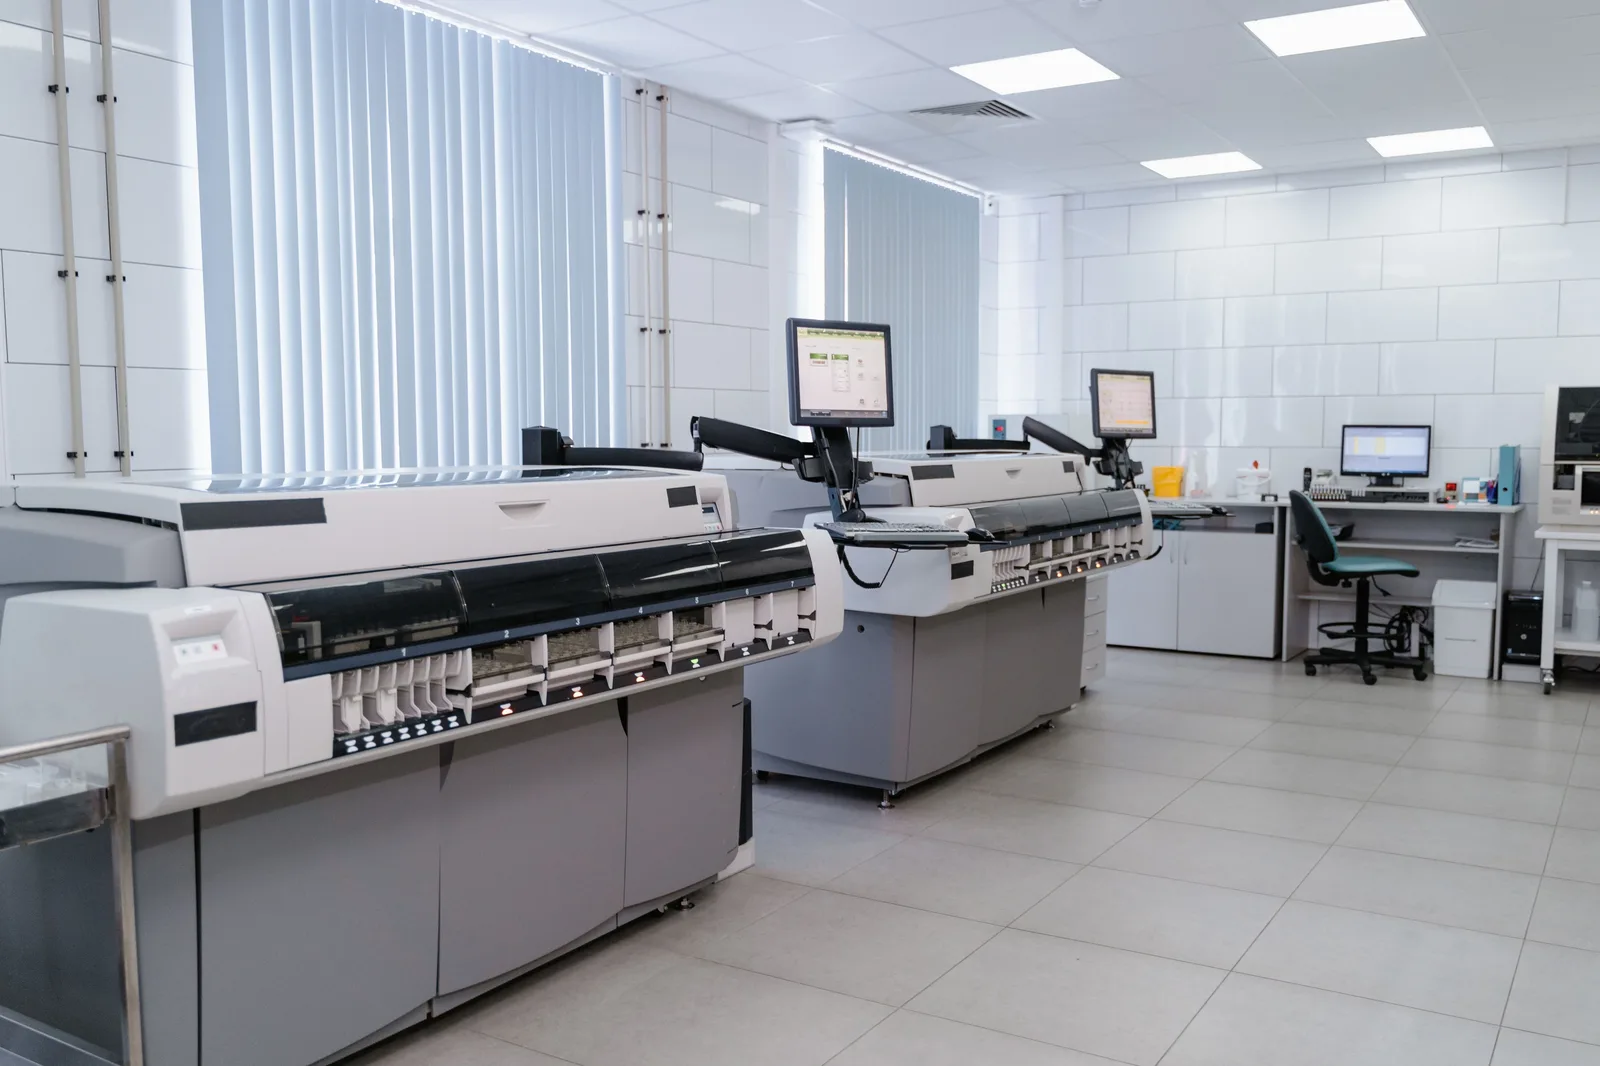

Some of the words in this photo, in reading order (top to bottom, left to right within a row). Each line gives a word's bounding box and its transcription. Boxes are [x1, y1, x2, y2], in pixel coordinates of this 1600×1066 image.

[401, 647, 407, 657] 1
[504, 629, 510, 638] 2
[575, 617, 581, 626] 3
[638, 606, 643, 614] 4
[694, 596, 699, 604] 5
[790, 580, 795, 588] 7
